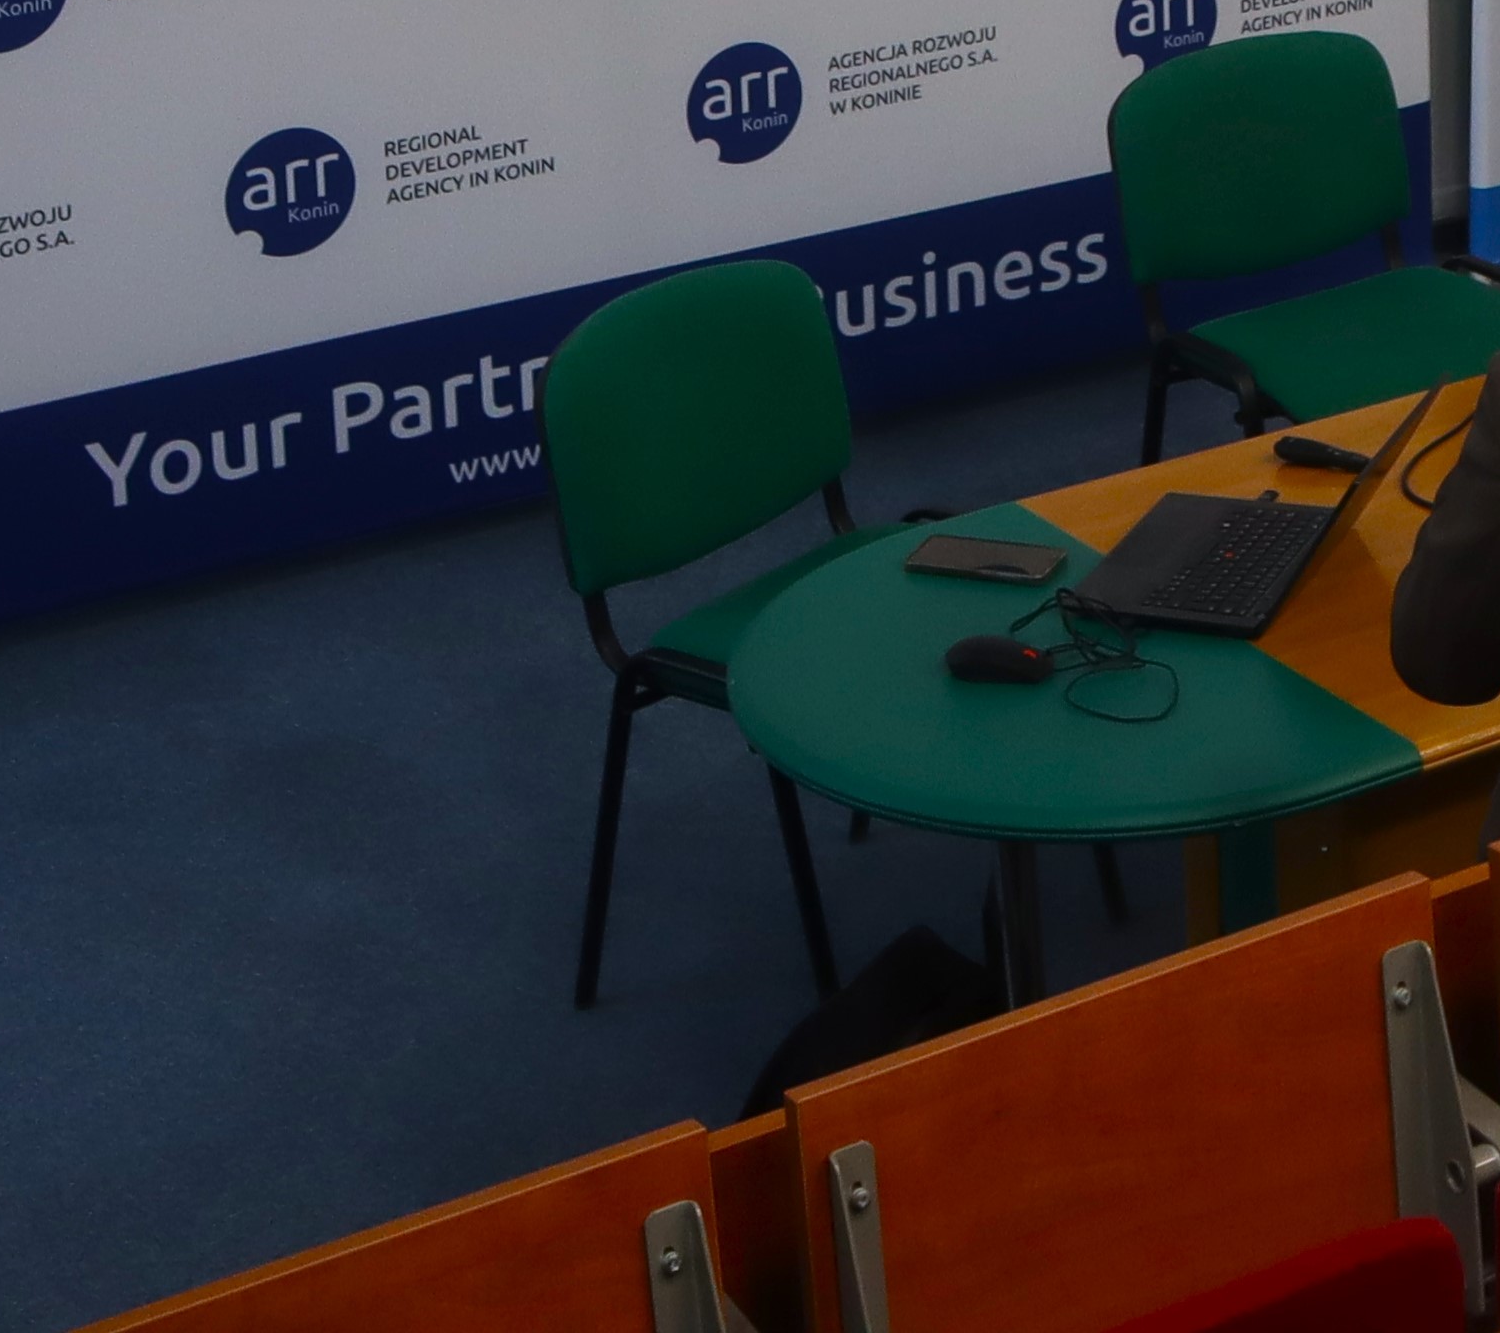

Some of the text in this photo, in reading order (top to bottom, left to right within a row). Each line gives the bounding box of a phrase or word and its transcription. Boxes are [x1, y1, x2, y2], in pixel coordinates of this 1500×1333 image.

[702, 66, 788, 121] arr
[243, 152, 339, 211] arr
[84, 412, 302, 507] Your
[835, 233, 1109, 337] usiness
